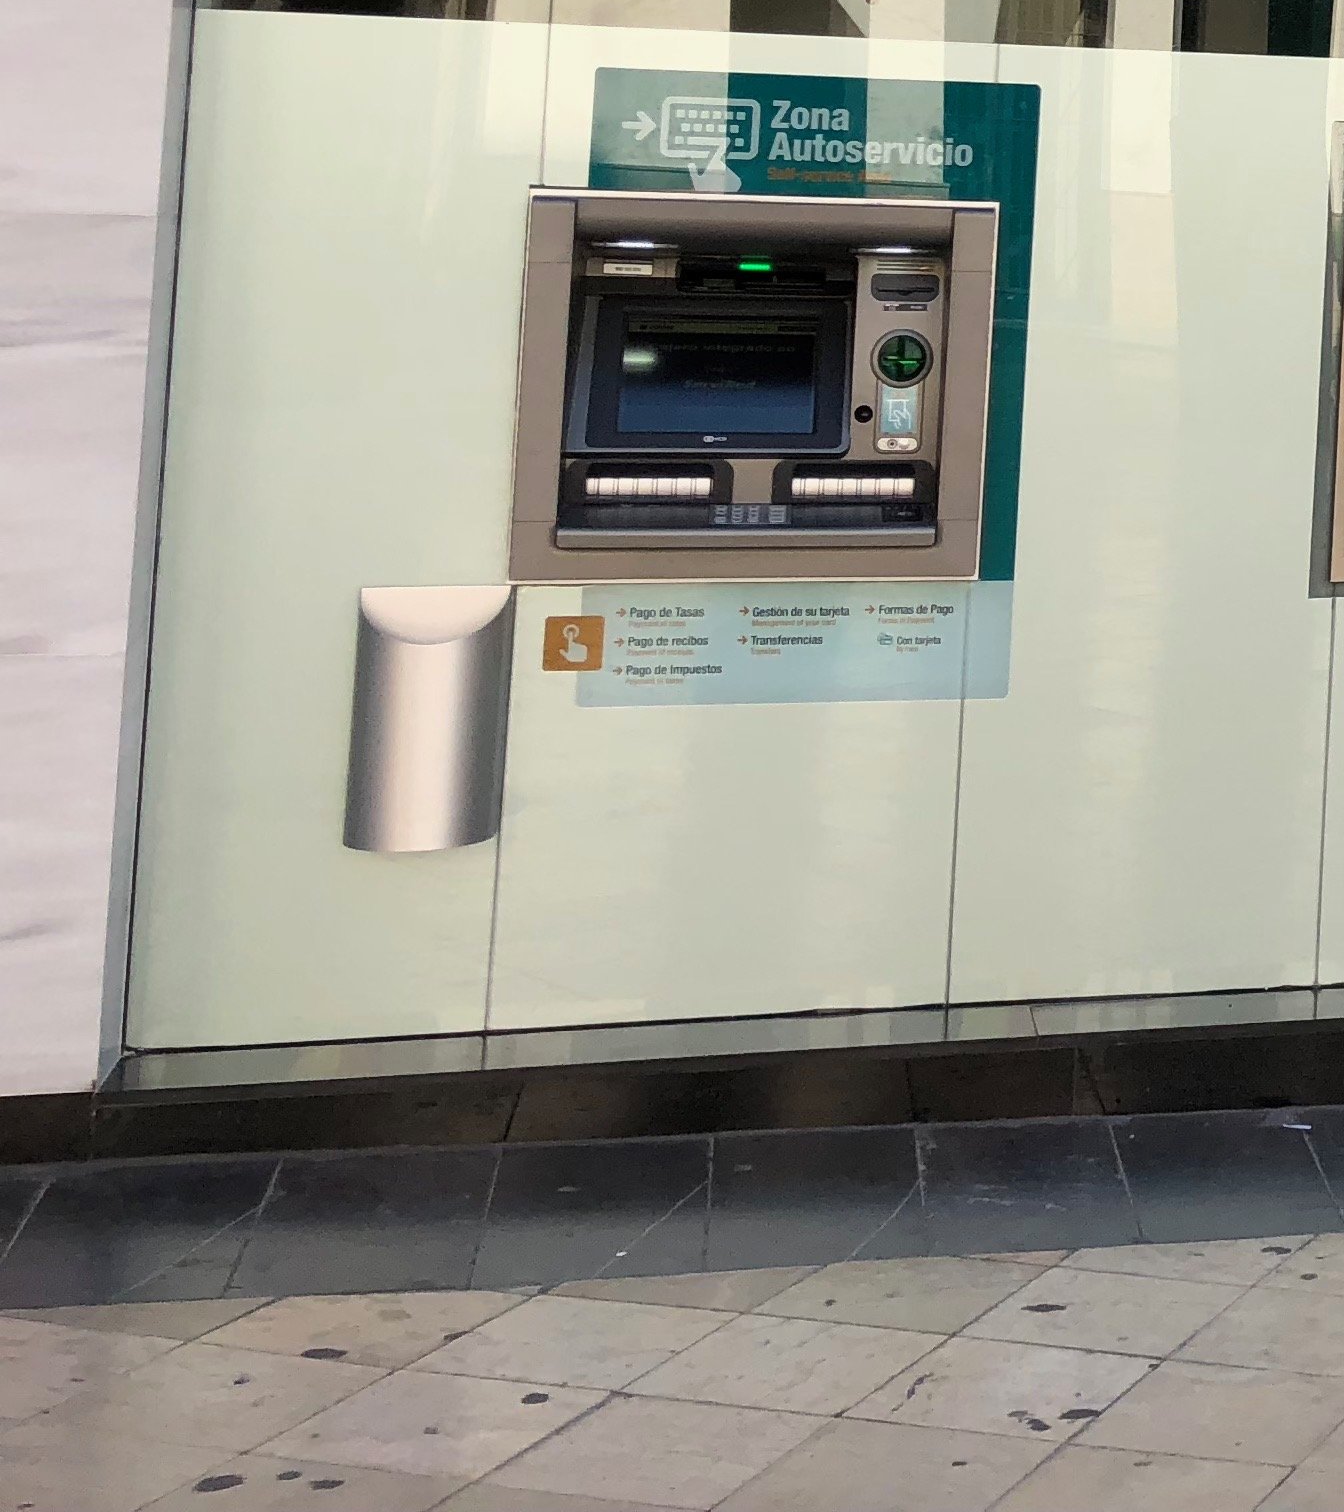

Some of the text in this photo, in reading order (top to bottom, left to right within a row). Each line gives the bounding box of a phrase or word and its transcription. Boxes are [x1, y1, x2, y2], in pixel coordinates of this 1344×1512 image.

[771, 100, 849, 131] Zona
[768, 132, 973, 167] Autoservicio
[630, 606, 705, 619] Pago de Tasas
[752, 605, 850, 619] Gestión de su tarjeta
[878, 604, 954, 617] Formas de Pago
[628, 635, 708, 648] Pago de recibos
[751, 635, 823, 646] Transferencias
[897, 636, 941, 647] Con tarjeta
[626, 665, 652, 677] Pago
[654, 664, 668, 675] de
